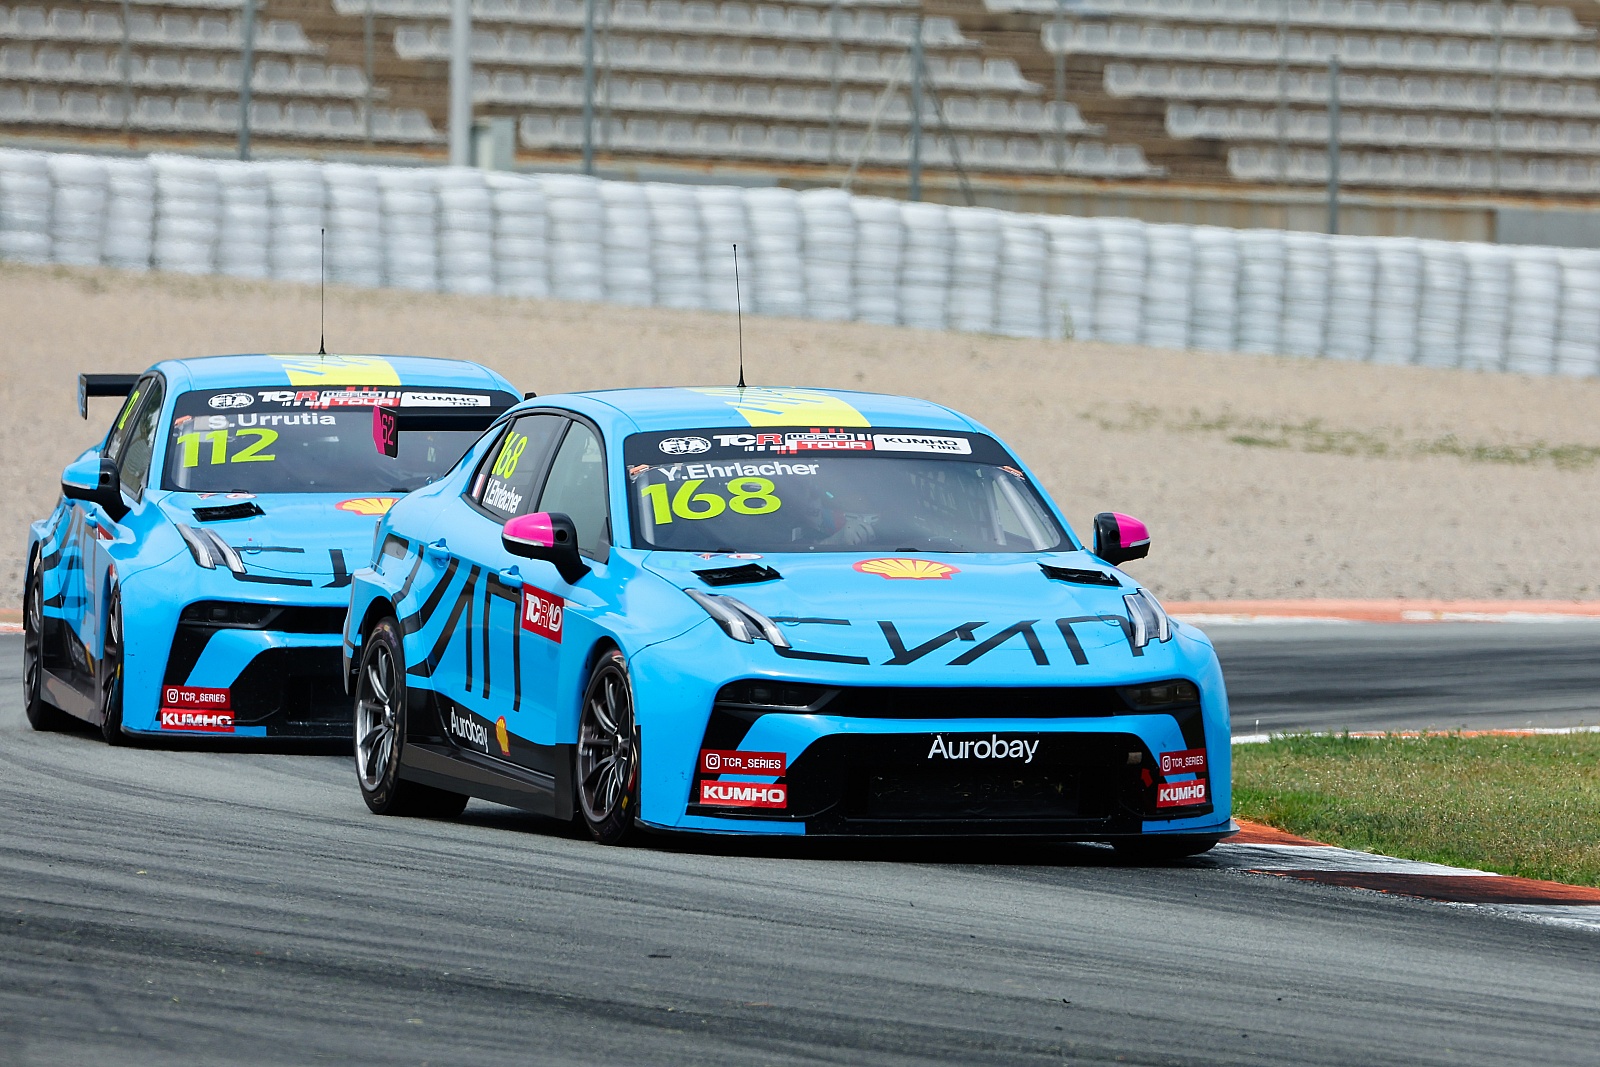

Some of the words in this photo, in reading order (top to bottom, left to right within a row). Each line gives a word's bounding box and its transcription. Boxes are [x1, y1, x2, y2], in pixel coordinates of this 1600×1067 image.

[258, 391, 319, 403] TCR
[335, 398, 394, 406] TOUR
[411, 395, 479, 403] KUMHO
[208, 412, 336, 427] S.Urrutia
[712, 433, 783, 446] TCR
[790, 433, 849, 441] WORLD
[883, 437, 958, 446] KUMHO
[177, 428, 279, 468] 112
[801, 441, 867, 450] TOUR
[491, 431, 528, 479] 168
[657, 461, 820, 481] Y.Ehrlacher
[641, 477, 782, 525] 168
[180, 691, 226, 703] TCR_SERIES
[162, 712, 233, 728] KUMHO
[450, 706, 489, 754] Aurobay
[927, 733, 1040, 764] Aurobay
[722, 757, 782, 769] TCR_SERIES
[1171, 755, 1204, 768] TCR_SERIES
[703, 785, 785, 803] KUMHO
[1159, 784, 1205, 802] KUMHO
